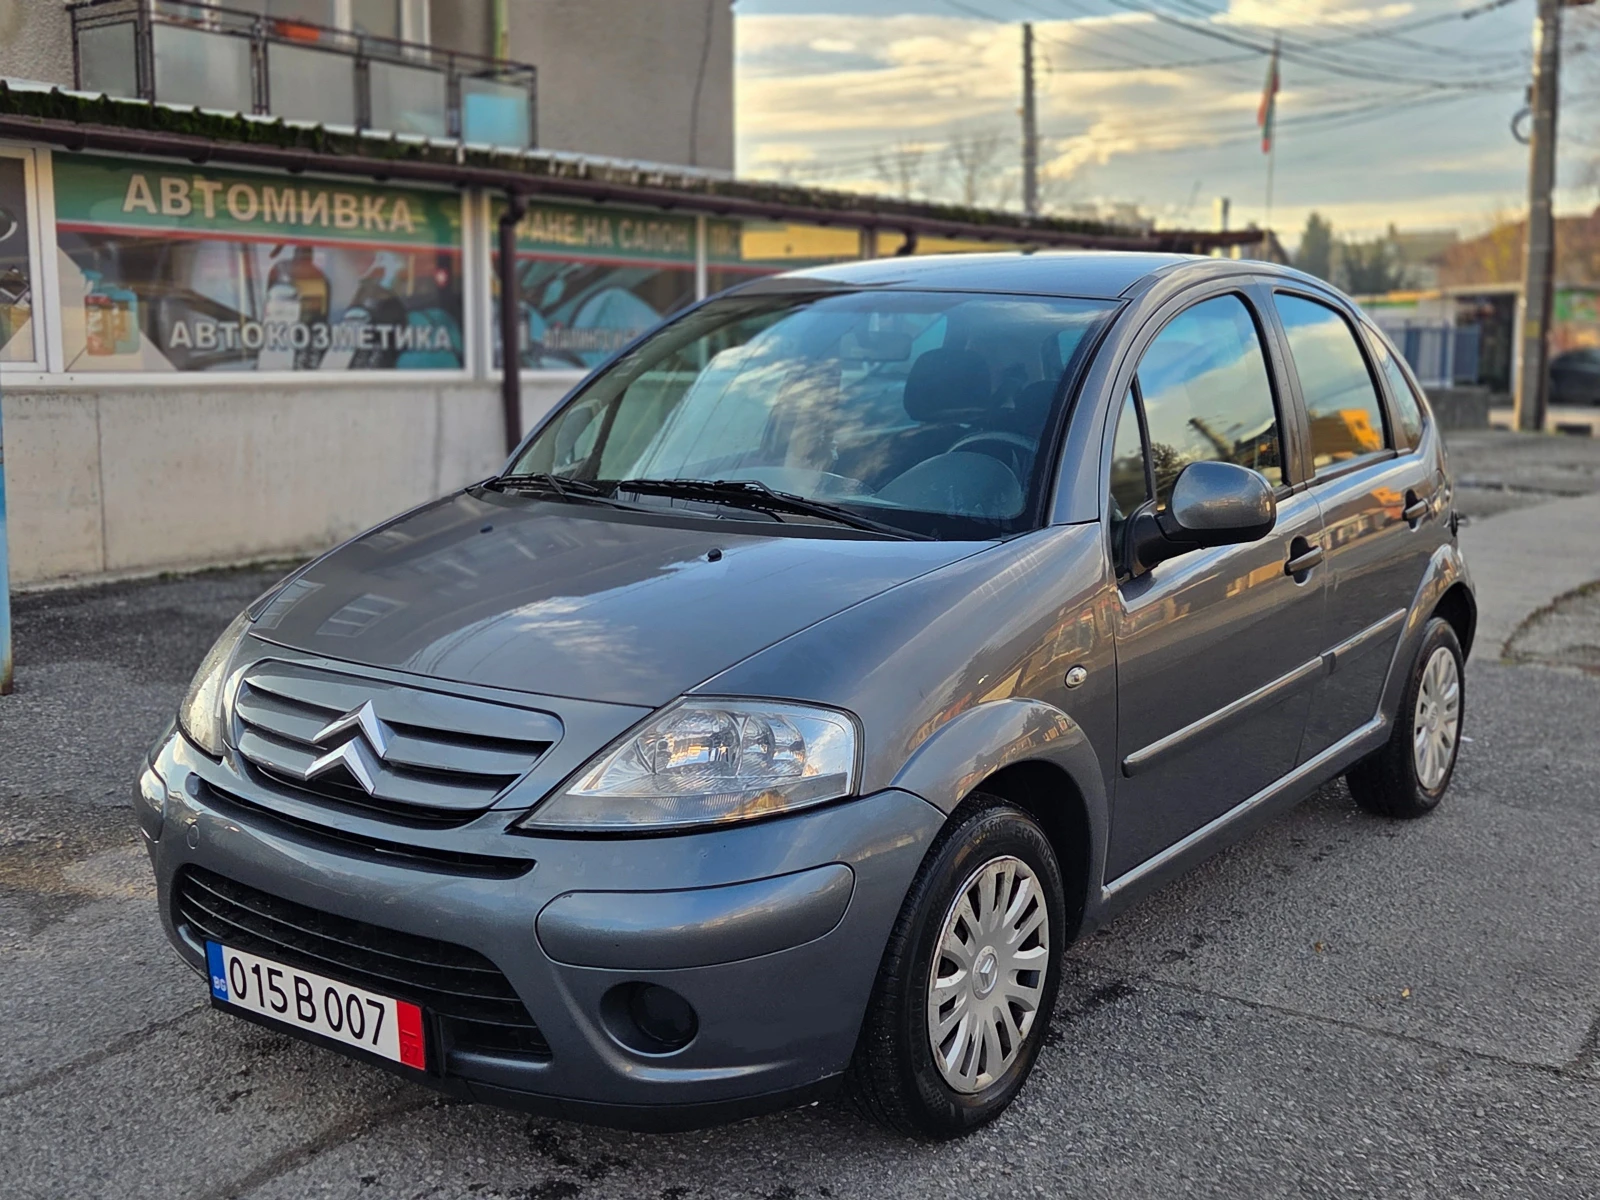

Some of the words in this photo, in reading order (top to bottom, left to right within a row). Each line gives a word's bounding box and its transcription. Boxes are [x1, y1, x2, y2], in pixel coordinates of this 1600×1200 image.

[122, 173, 415, 234] АВТОМИВКА
[583, 214, 614, 248] НА
[169, 319, 452, 351] АВТОКОЗМЕТИКА
[213, 975, 227, 992] BG
[229, 956, 385, 1046] 015B007
